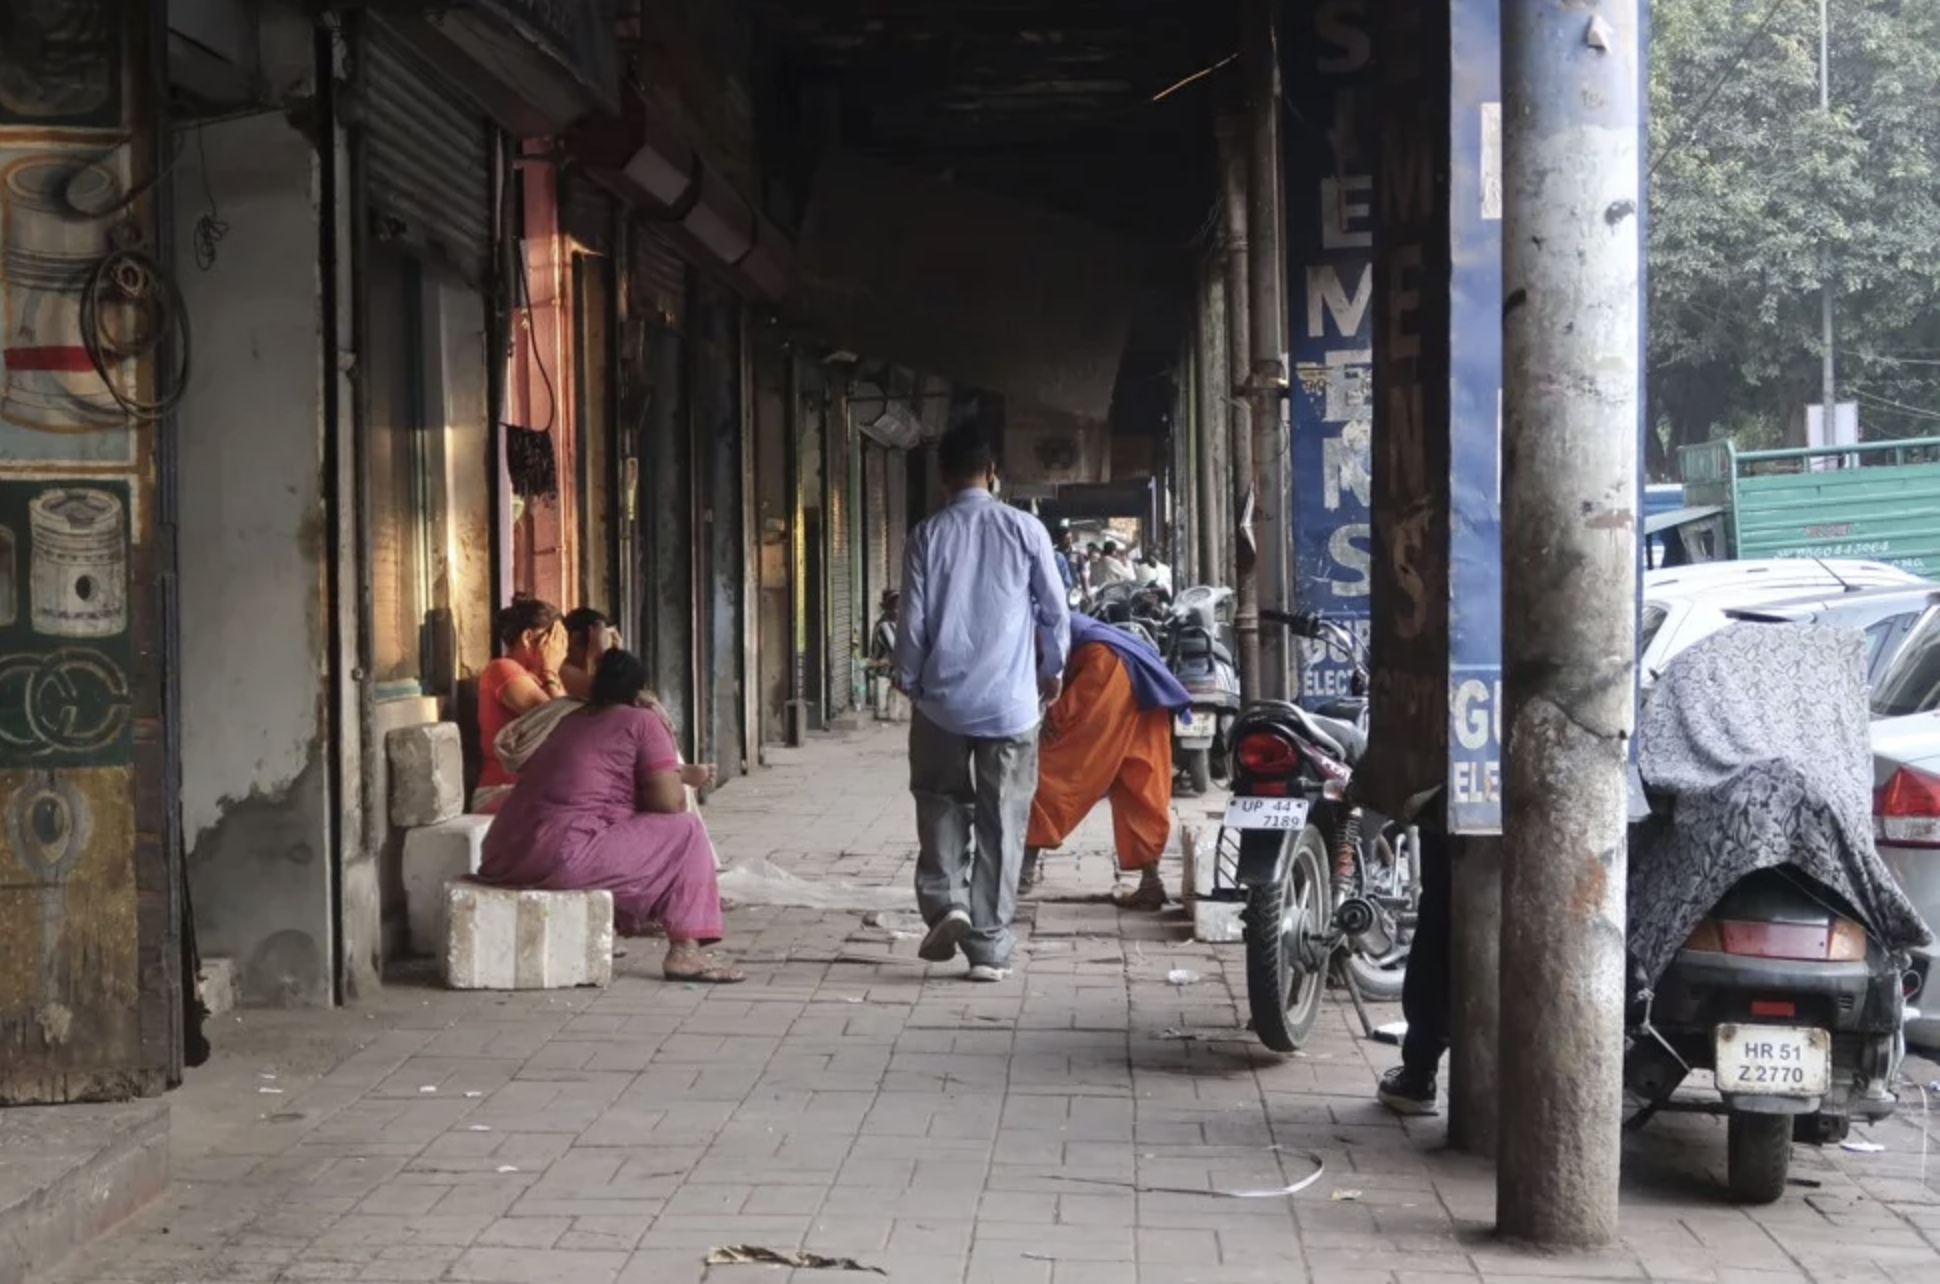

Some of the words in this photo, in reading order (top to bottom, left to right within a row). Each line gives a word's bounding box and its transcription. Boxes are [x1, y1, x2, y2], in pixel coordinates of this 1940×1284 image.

[1242, 799, 1264, 812] UP
[1273, 801, 1292, 812] 44
[1263, 814, 1300, 828] 7189
[1744, 1042, 1774, 1059] HR
[1779, 1043, 1802, 1061] 51
[1738, 1065, 1754, 1082] Z
[1756, 1066, 1804, 1083] 2770
